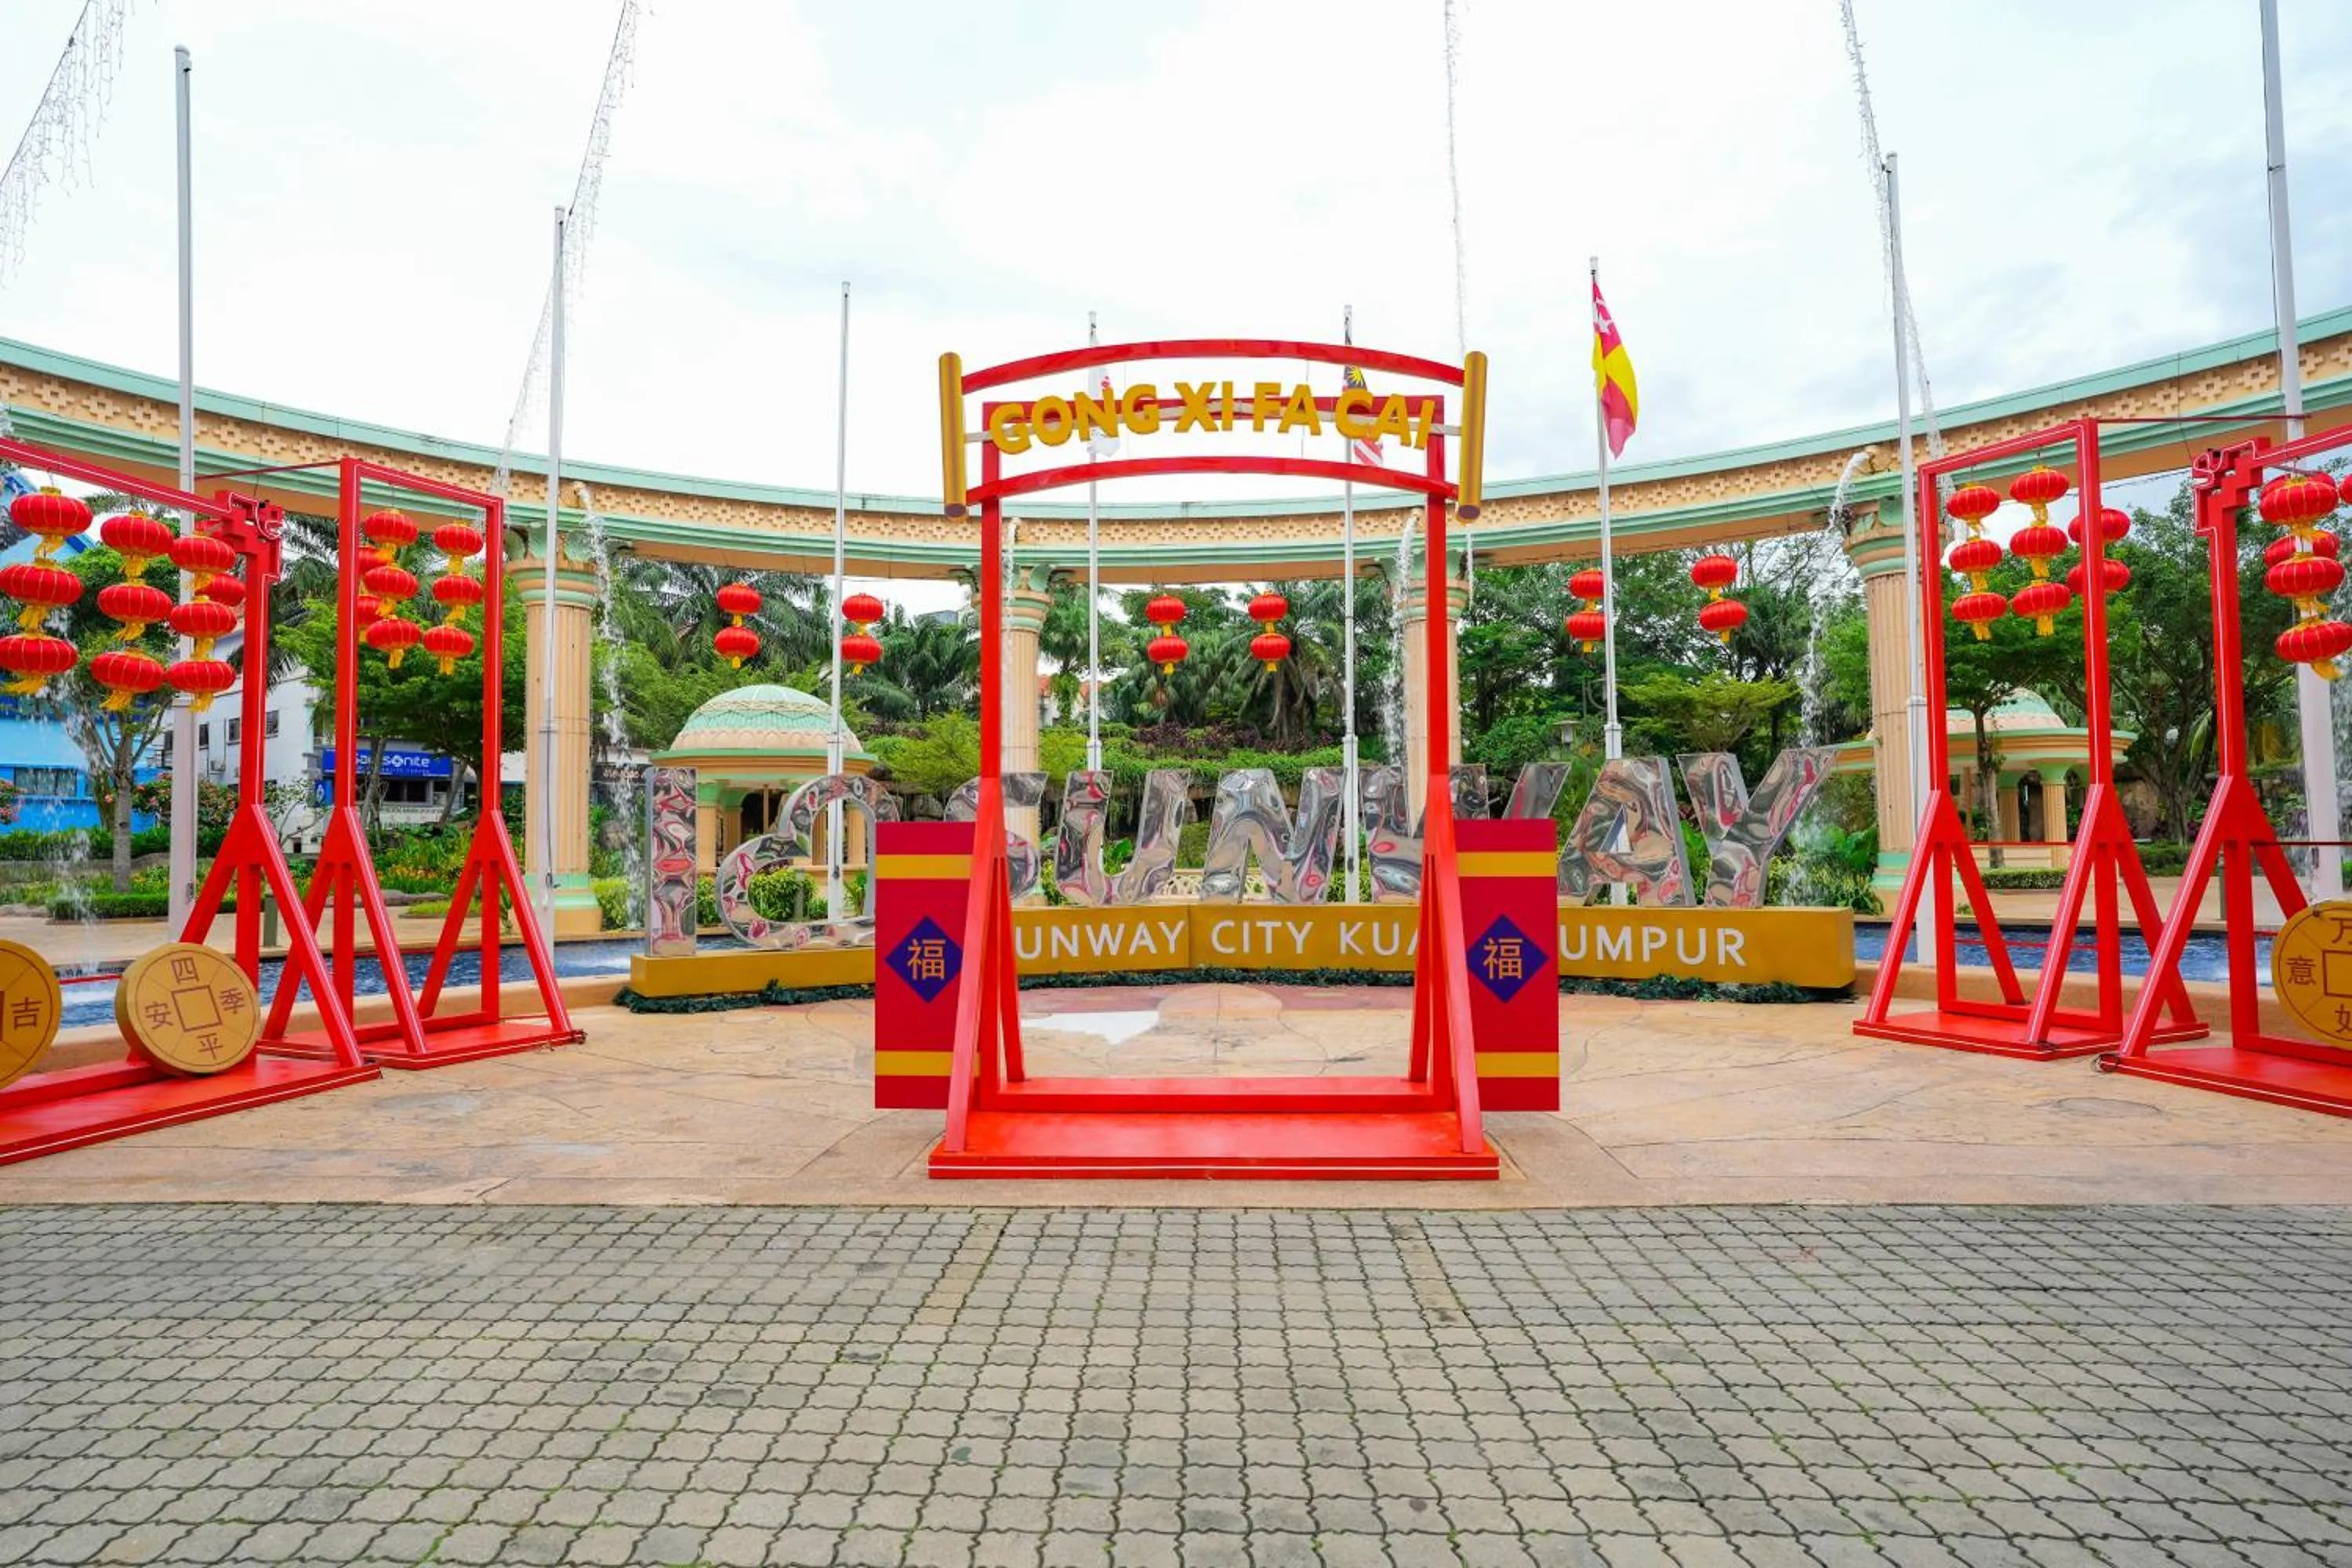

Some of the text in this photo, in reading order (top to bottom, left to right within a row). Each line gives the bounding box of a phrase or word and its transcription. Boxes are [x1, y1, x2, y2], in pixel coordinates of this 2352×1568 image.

[989, 381, 1436, 455] GONG XI FA CAI
[906, 938, 946, 981] 福
[1015, 920, 1186, 960] UNWAY
[1210, 920, 1313, 954] CITY
[1560, 924, 1747, 967] UMPUR
[1483, 937, 1523, 980] 福
[2286, 956, 2317, 985] 意
[10, 996, 42, 1030] 吉
[145, 956, 245, 1061] 四 季 平 安
